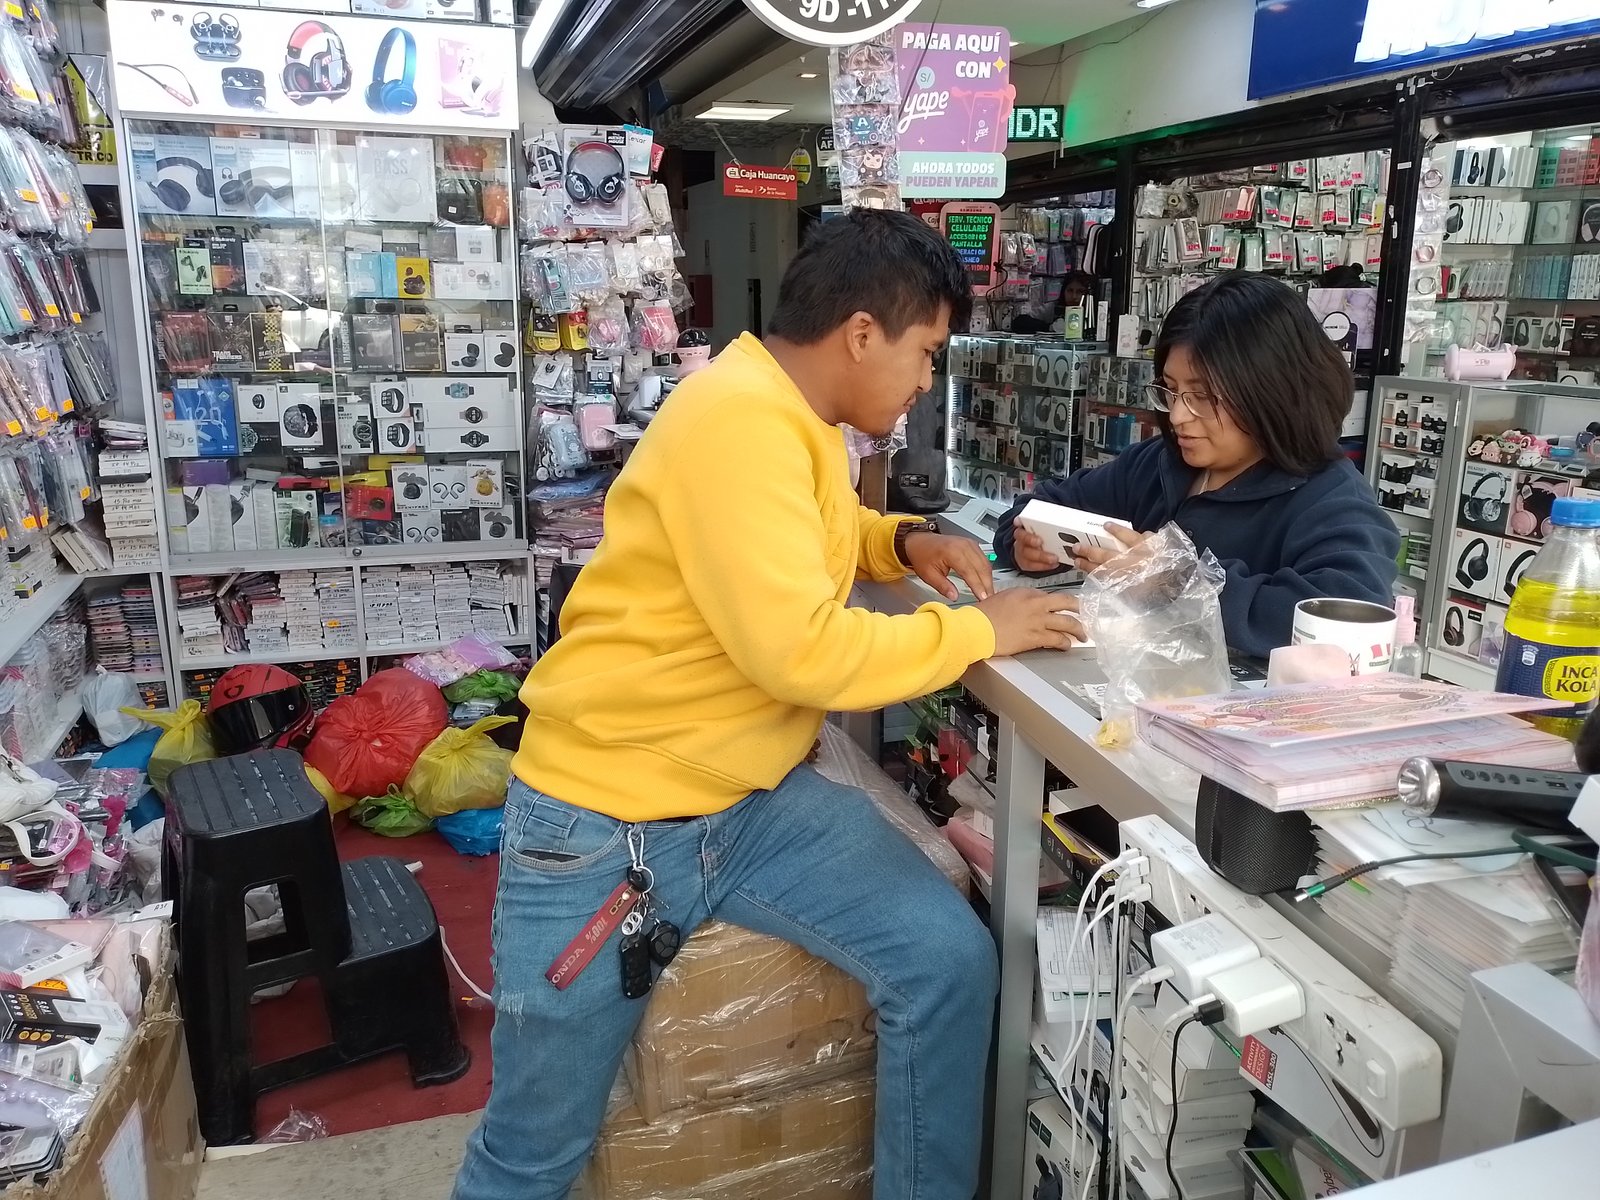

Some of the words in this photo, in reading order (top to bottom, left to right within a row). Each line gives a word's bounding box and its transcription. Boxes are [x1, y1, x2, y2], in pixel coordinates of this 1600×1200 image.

[902, 32, 951, 50] PAGA
[955, 32, 1001, 54] AQUÍ
[955, 60, 991, 78] CON
[920, 72, 931, 83] S/
[897, 91, 949, 134] yape
[1008, 107, 1059, 138] DR
[912, 162, 953, 174] AHORA
[956, 163, 994, 175] TODOS
[740, 169, 757, 180] Caja
[758, 170, 796, 183] Huancayo
[906, 176, 952, 187] PUEDEN
[954, 177, 998, 188] YAPEAR
[948, 216, 964, 224] SERV.
[966, 216, 993, 224] TECNICO
[951, 224, 988, 232] CELULARES
[1562, 665, 1598, 679] INCA
[1556, 679, 1596, 692] KOLA
[551, 947, 585, 986] ONDA
[1246, 1039, 1256, 1070] ACTIVITY
[1255, 1045, 1266, 1080] DESIGN
